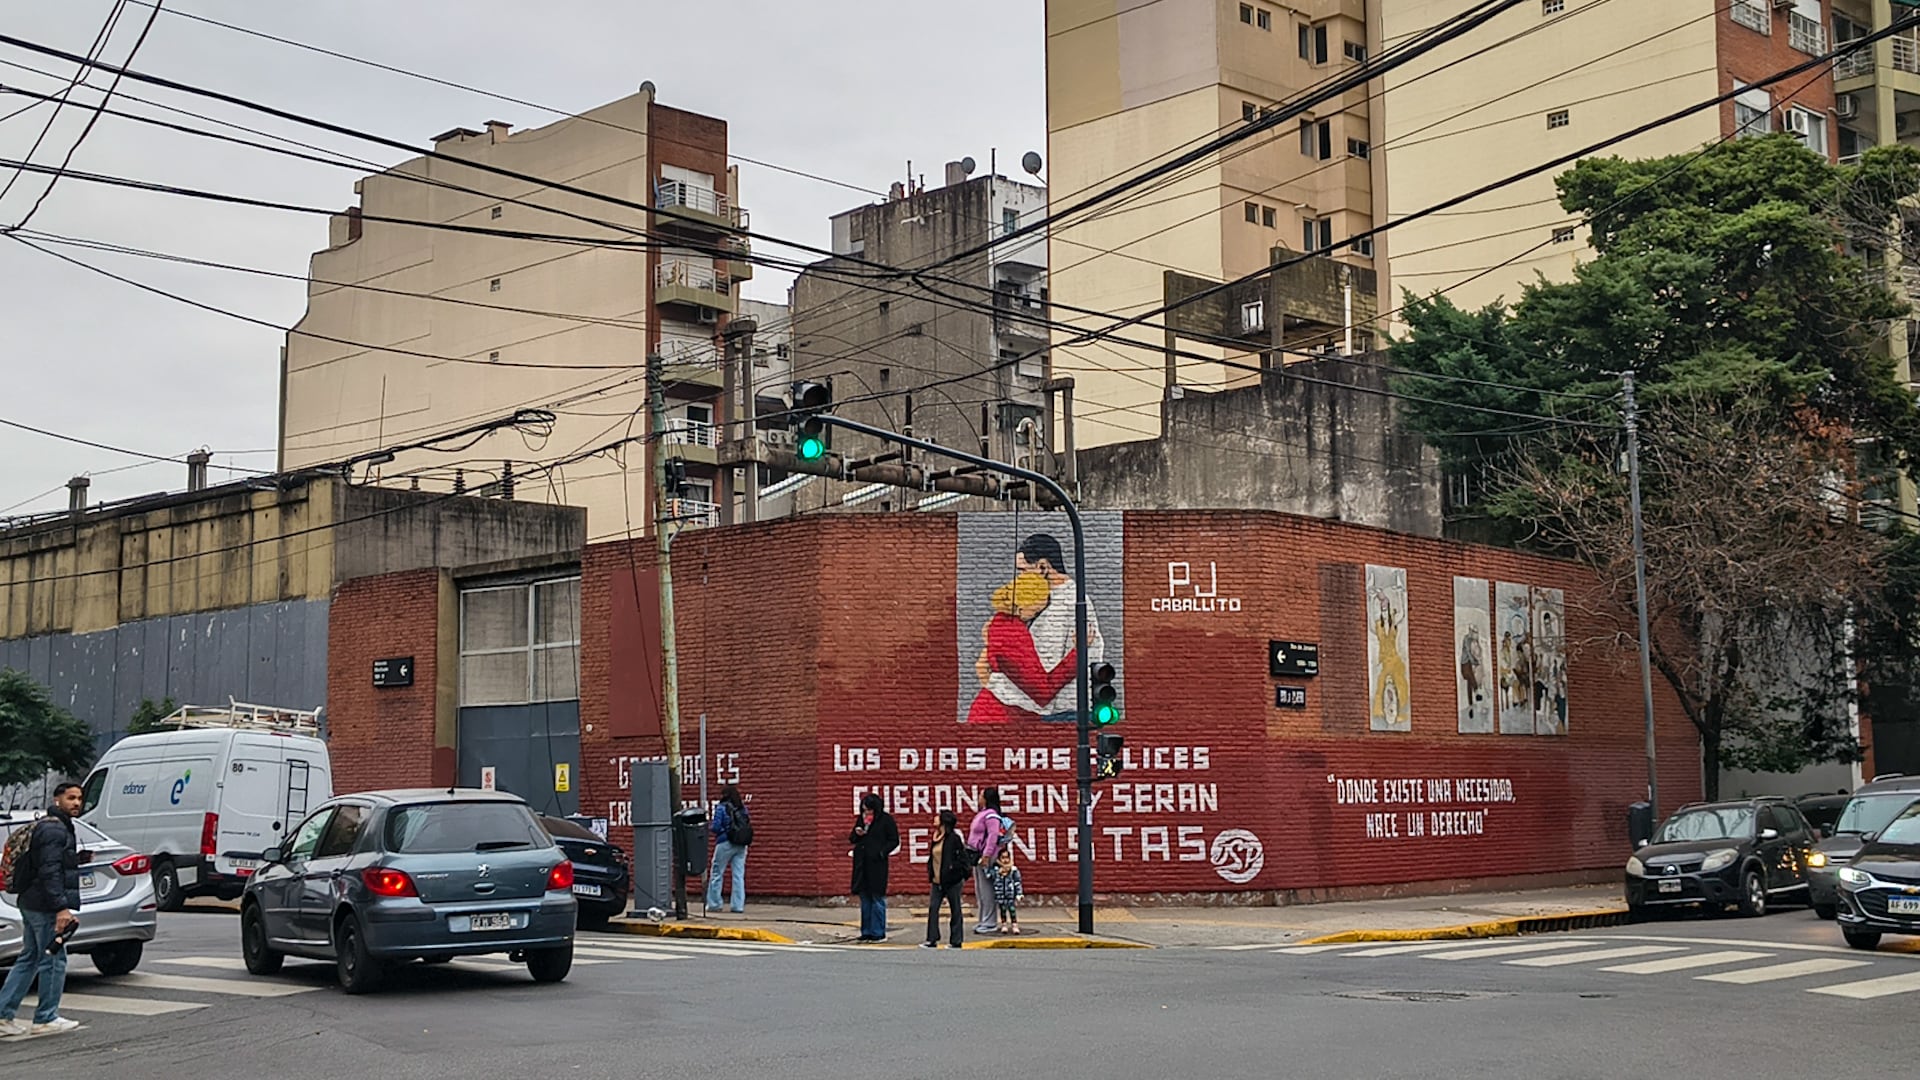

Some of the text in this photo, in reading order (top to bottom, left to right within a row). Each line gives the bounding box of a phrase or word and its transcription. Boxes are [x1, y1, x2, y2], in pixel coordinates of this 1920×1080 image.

[1168, 562, 1217, 597] PJ
[1151, 598, 1241, 611] CABALLITO
[716, 753, 740, 785] ES
[833, 743, 881, 772] LOS
[899, 748, 986, 771] DIAS
[1004, 747, 1071, 771] MAS
[998, 783, 1069, 814] SON
[1112, 782, 1218, 813] SERAN
[1383, 779, 1424, 803] EXISTE
[1427, 779, 1451, 803] UNA
[1366, 813, 1399, 838] NACE
[1407, 812, 1425, 837] UN
